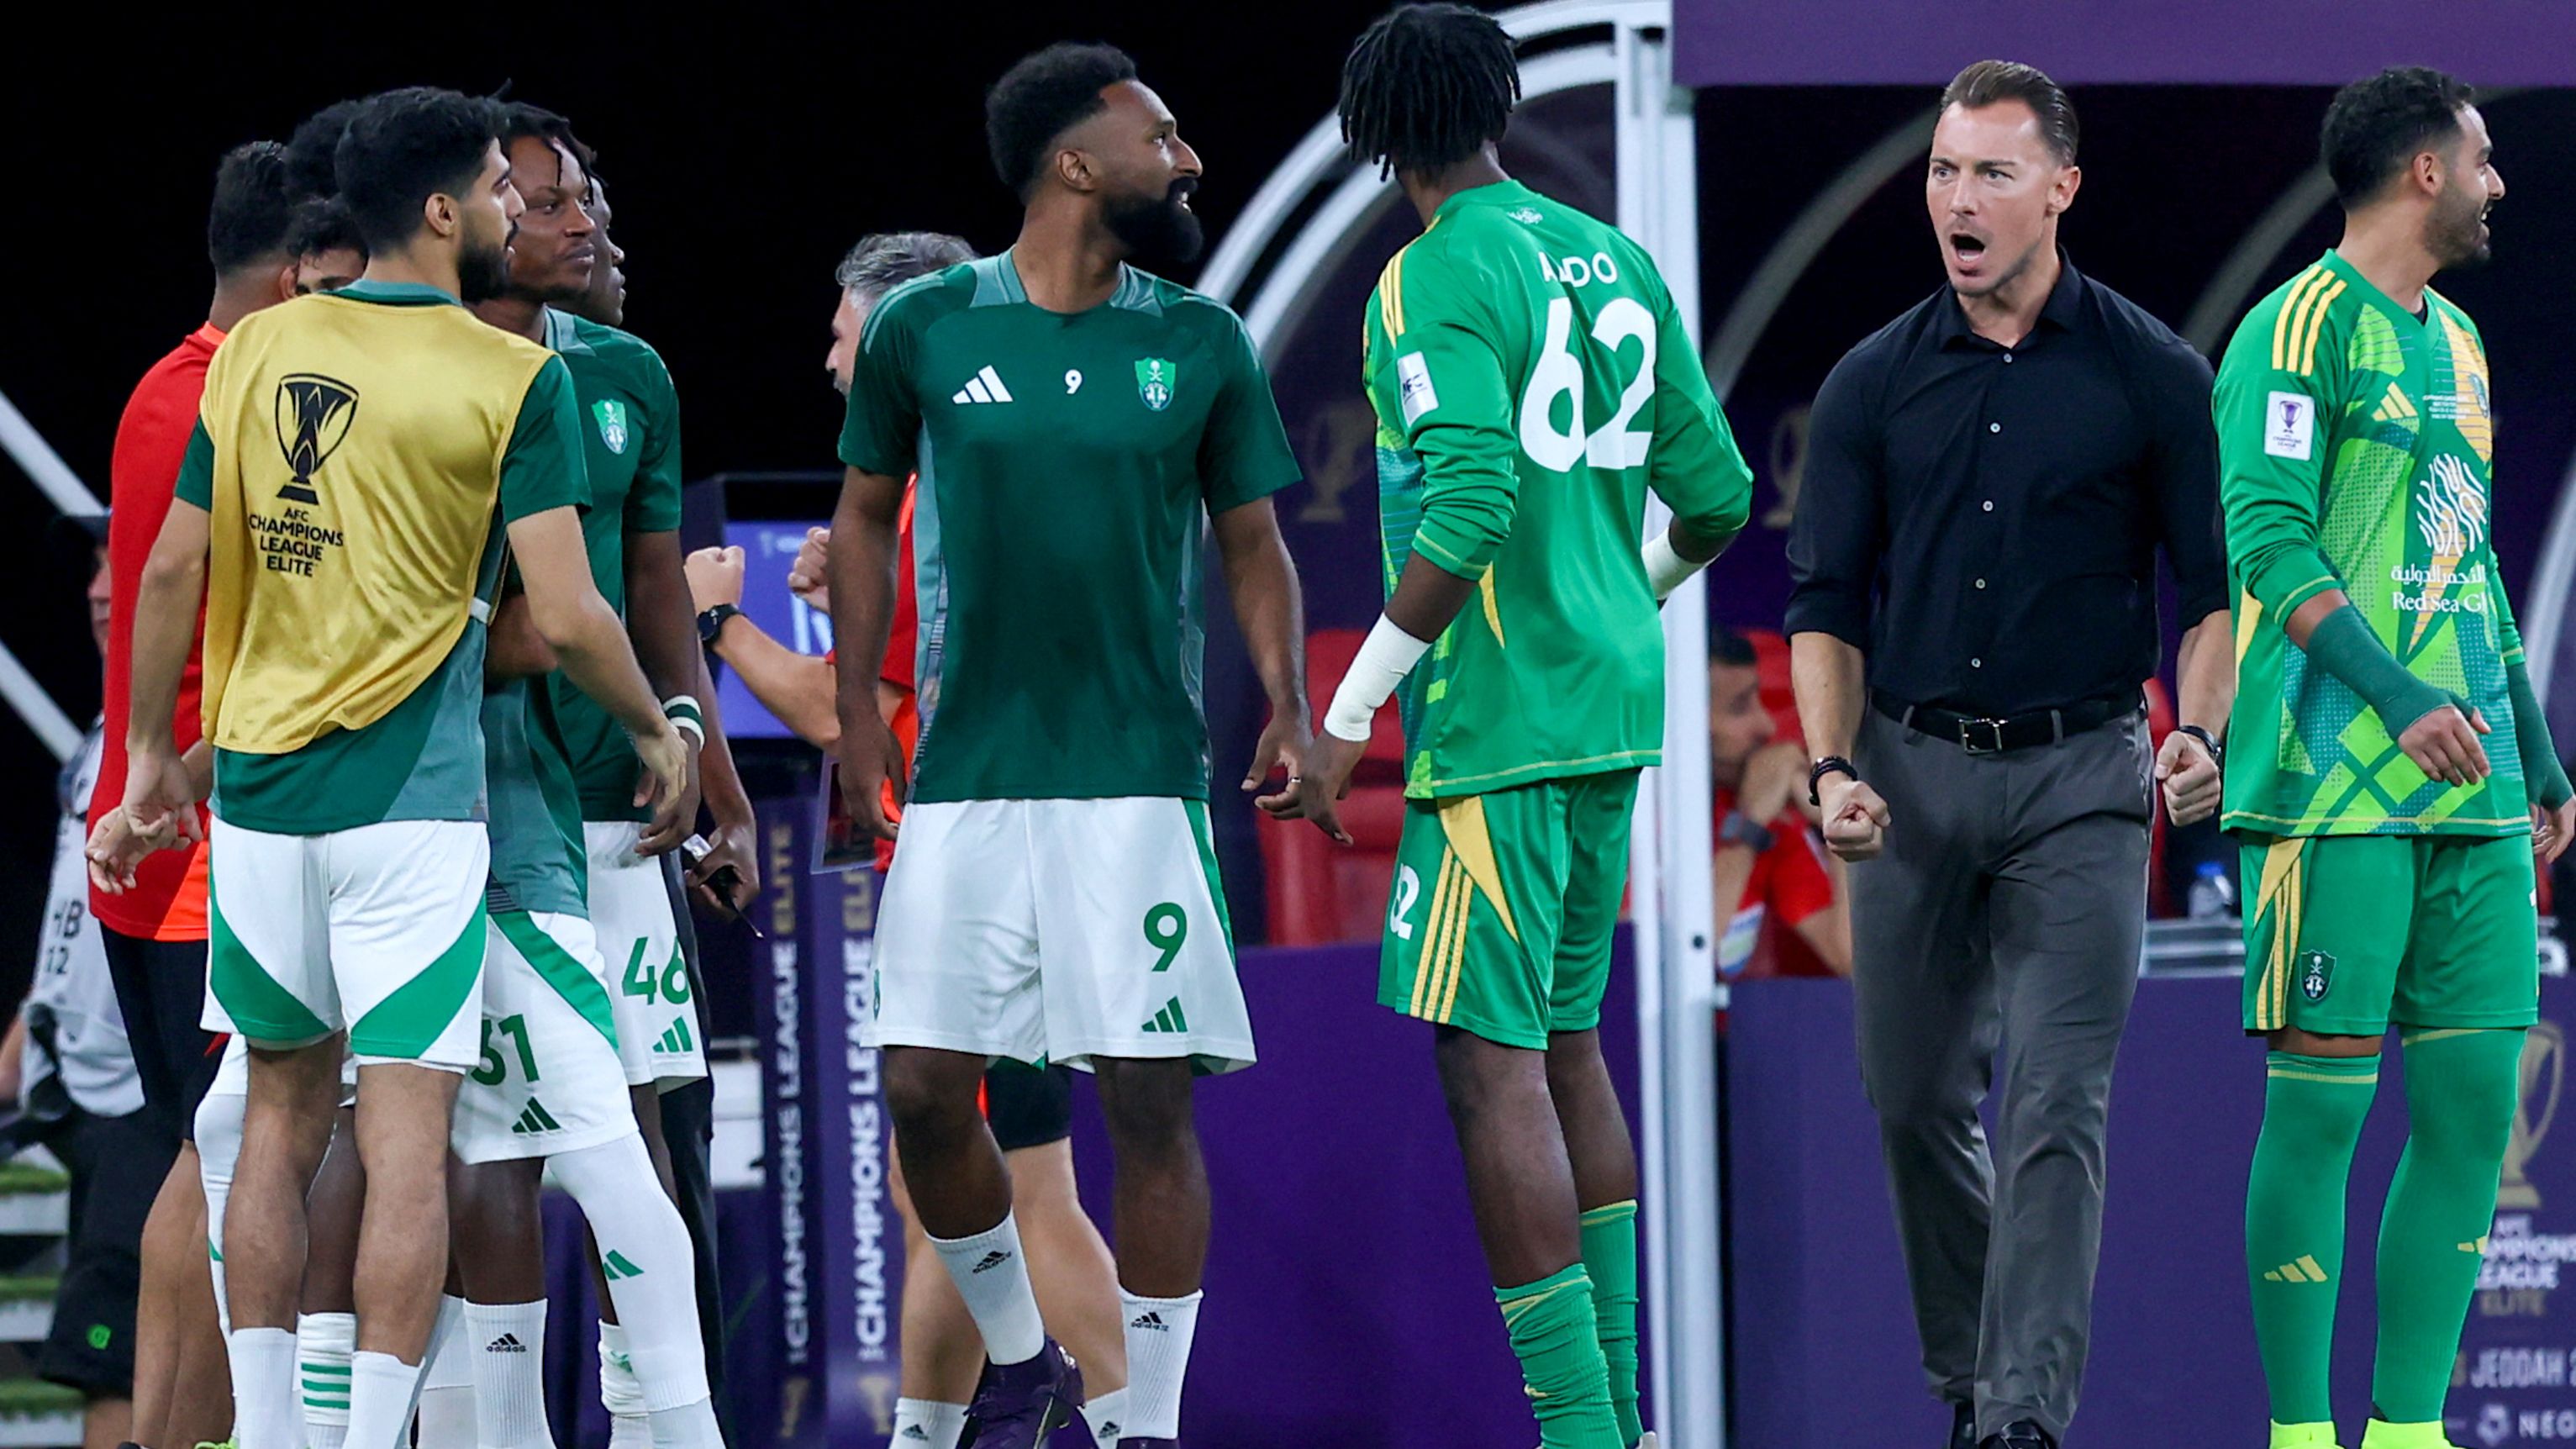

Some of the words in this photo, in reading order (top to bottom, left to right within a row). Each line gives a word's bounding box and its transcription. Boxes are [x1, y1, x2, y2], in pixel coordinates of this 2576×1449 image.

[1064, 368, 1083, 394] 9
[1519, 296, 1657, 473] 62
[249, 514, 344, 546] CHAMPIONS
[283, 507, 309, 522] AFC
[259, 535, 324, 561] LEAGUE
[266, 555, 313, 577] ELITE
[2392, 590, 2426, 611] Red
[2430, 593, 2460, 613] Sea
[771, 824, 795, 935] ELITE
[842, 870, 872, 932] ELI
[1143, 902, 1188, 972] 9
[621, 935, 690, 1005] 46
[772, 941, 799, 1098] LEAGUE
[843, 938, 878, 1095] LEAGUE
[778, 1103, 810, 1350] CHAMPIONS
[849, 1101, 888, 1345] CHAMPIONS
[2477, 1261, 2560, 1290] EAGUE
[486, 1345, 527, 1353] adidas
[2471, 1346, 2565, 1388] JEDDAH
